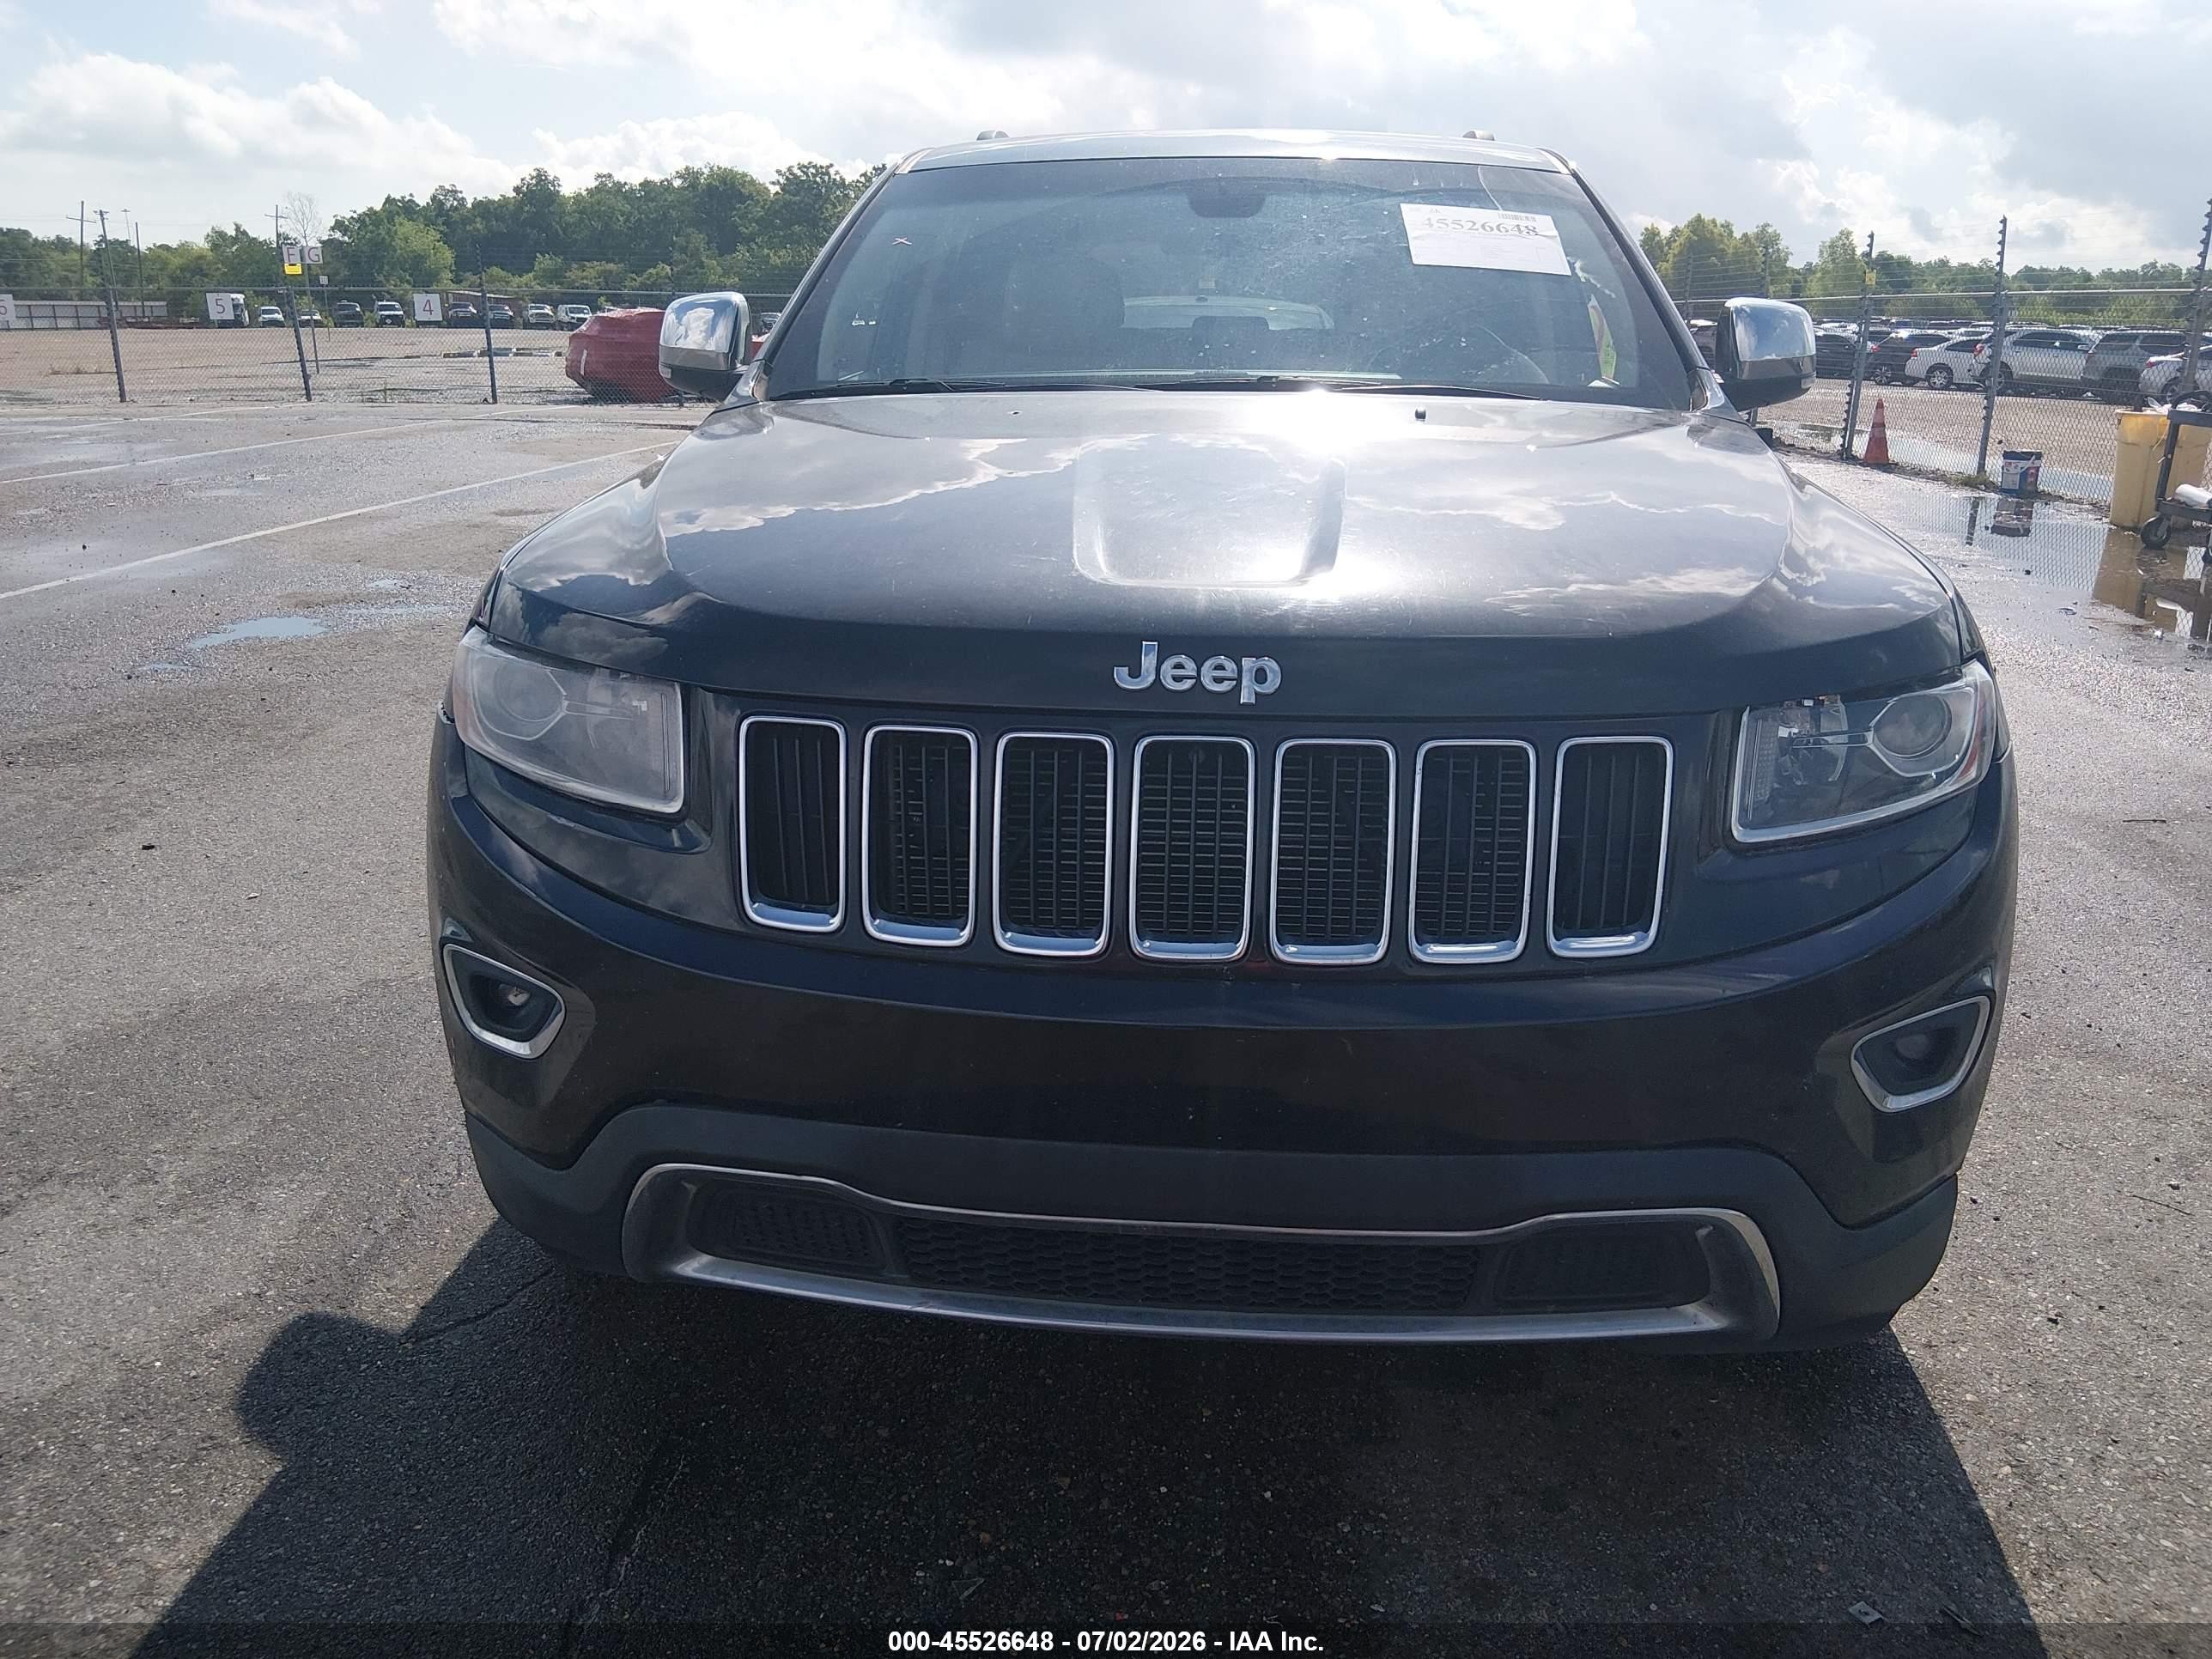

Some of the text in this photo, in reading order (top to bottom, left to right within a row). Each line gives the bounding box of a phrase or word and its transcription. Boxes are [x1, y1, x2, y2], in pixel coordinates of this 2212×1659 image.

[1422, 216, 1538, 236] 45526648
[286, 246, 295, 263] F
[307, 246, 321, 263] G
[215, 298, 226, 314] 5
[422, 299, 434, 315] 4
[1113, 641, 1282, 705] Jeep
